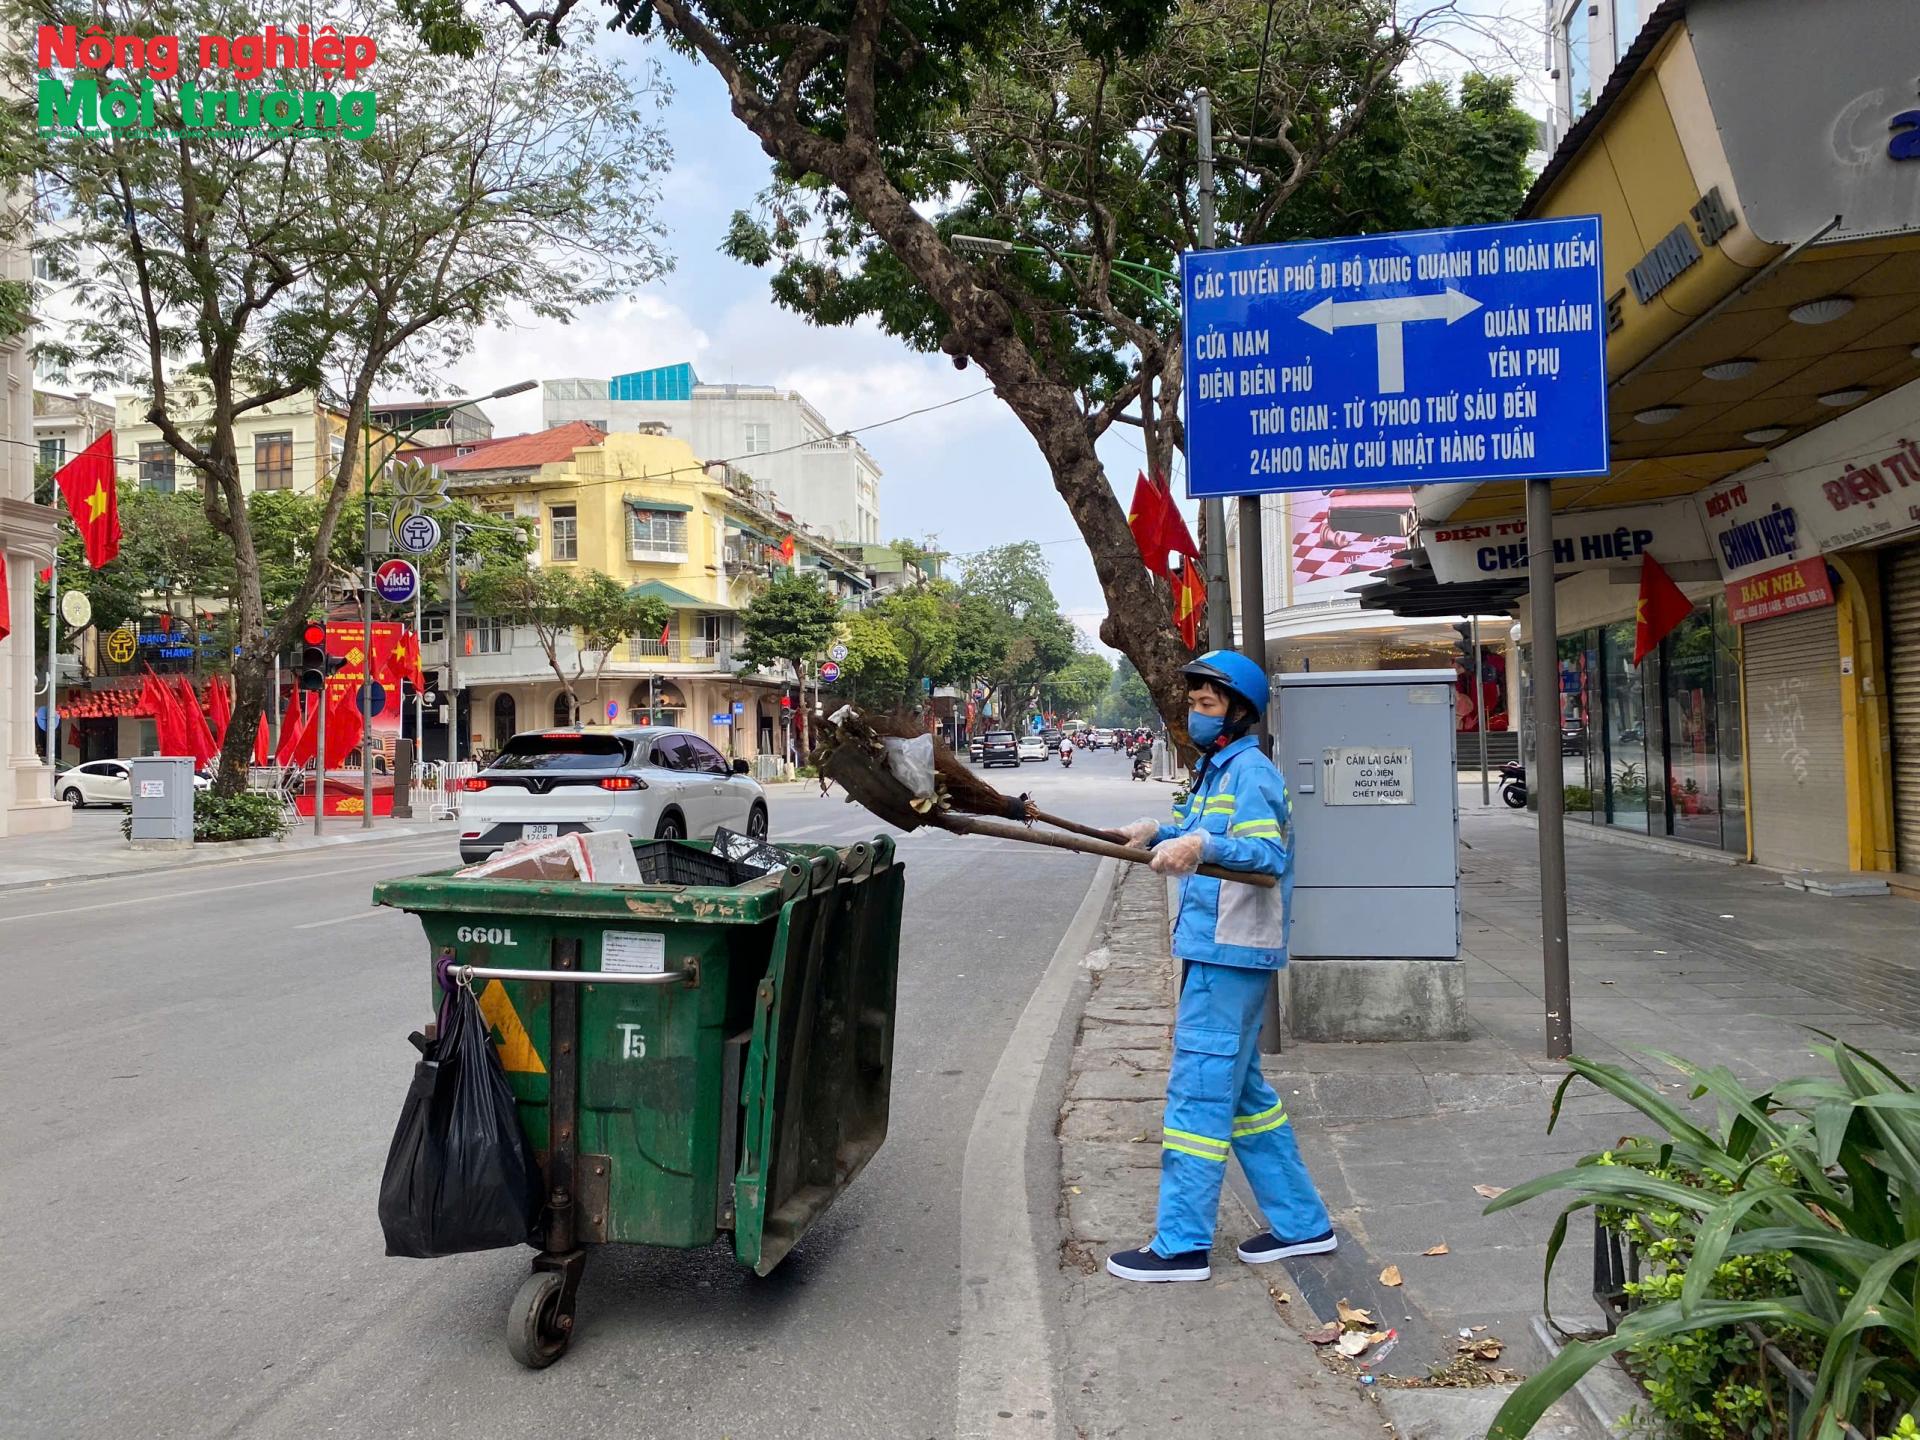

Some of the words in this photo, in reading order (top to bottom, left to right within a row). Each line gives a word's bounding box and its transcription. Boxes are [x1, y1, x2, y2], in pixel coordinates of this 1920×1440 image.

[1194, 267, 1224, 299] CÁC
[1229, 259, 1278, 297] TUYẾN
[1284, 256, 1316, 292] PHỐ
[1321, 263, 1336, 288] ĐI
[1342, 255, 1362, 291] BỘ
[1368, 256, 1411, 284] XUNG
[1417, 251, 1472, 280] QUANH
[1478, 239, 1500, 275] HỒ
[1505, 238, 1549, 273] HOÀN
[1554, 232, 1595, 268] KIẾM
[1484, 304, 1529, 338] QUÁN
[1536, 300, 1592, 334] THÁNH
[1196, 324, 1227, 360] CỬA
[1233, 329, 1269, 357] NAM
[1199, 367, 1234, 403] ĐIỆN
[1240, 363, 1276, 396] BIÊN
[1282, 355, 1313, 393] PHỦ
[1488, 345, 1521, 378] YÊN
[1527, 348, 1560, 381] PHỤ
[1250, 402, 1285, 435] THỜI
[1343, 396, 1365, 429] TỪ
[1371, 398, 1421, 428] 19H00
[1426, 389, 1459, 423] THỨ
[1464, 388, 1497, 422] SÁU
[1503, 383, 1537, 419] ĐẾN
[1250, 446, 1302, 475] 24H00
[1308, 438, 1349, 472] NGÀY
[1354, 431, 1386, 468] CHỦ
[1391, 432, 1435, 470] NHẬT
[1440, 430, 1485, 463] HÀNG
[1491, 424, 1535, 460] TUẦN
[1435, 525, 1491, 543] ĐIỆN
[1477, 537, 1575, 572] CHÍH
[1580, 527, 1654, 561] HIỆP
[1719, 519, 1767, 570] CHÍNH
[1758, 502, 1799, 560] HIỆP
[379, 568, 410, 586] Vikki
[1740, 577, 1769, 603] BÁN
[532, 825, 548, 833] 30B
[457, 926, 518, 946] 660L
[616, 1023, 646, 1060] T5
